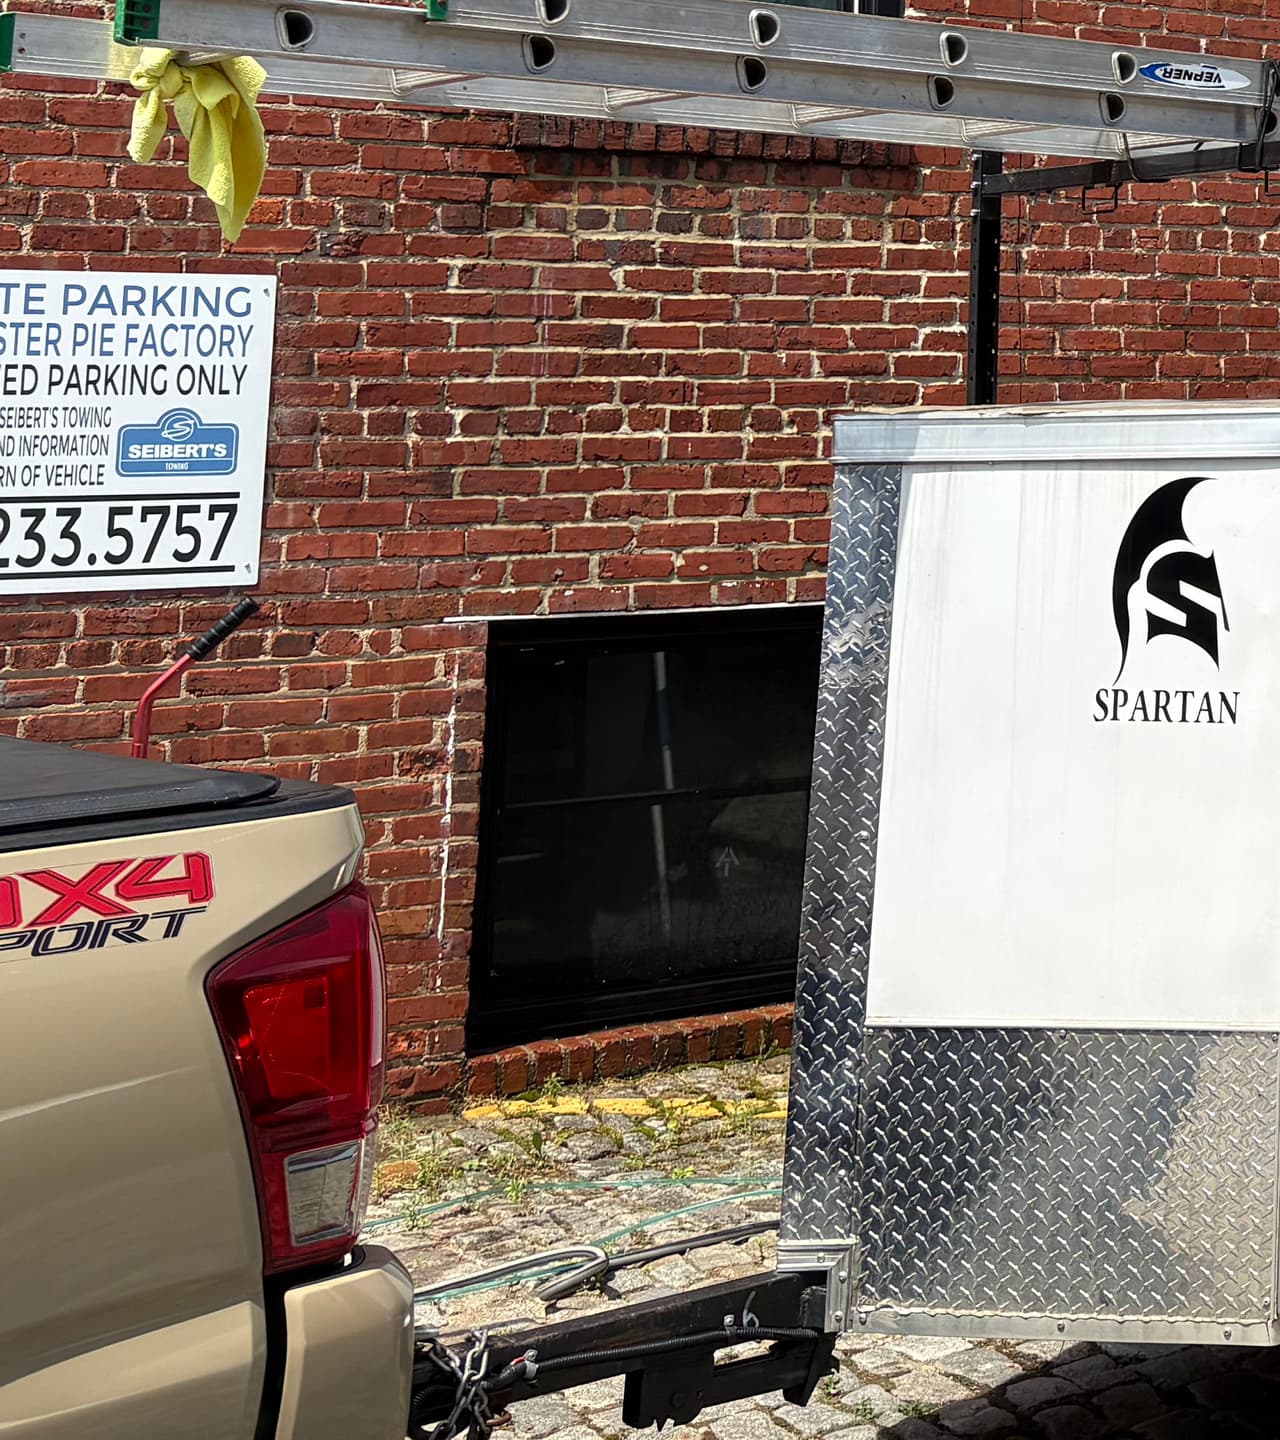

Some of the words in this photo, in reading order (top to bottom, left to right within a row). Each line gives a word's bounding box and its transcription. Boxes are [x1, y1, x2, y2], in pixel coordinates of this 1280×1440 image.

[0, 282, 46, 315] TE
[62, 283, 252, 318] PARKING
[72, 323, 115, 357] PIE
[124, 323, 255, 358] FACTORY
[48, 364, 168, 396] PARKING
[176, 364, 248, 396] ONLY
[0, 406, 59, 428] SEIBERT'S
[62, 406, 112, 428] TOWING
[18, 434, 110, 457] INFORMATION
[127, 443, 228, 459] SEIBERT'S
[21, 465, 42, 487] OF
[45, 464, 106, 487] VEHICLE
[165, 462, 190, 471] TOWING
[1093, 688, 1240, 725] SPARTAN
[0, 850, 215, 930] X4
